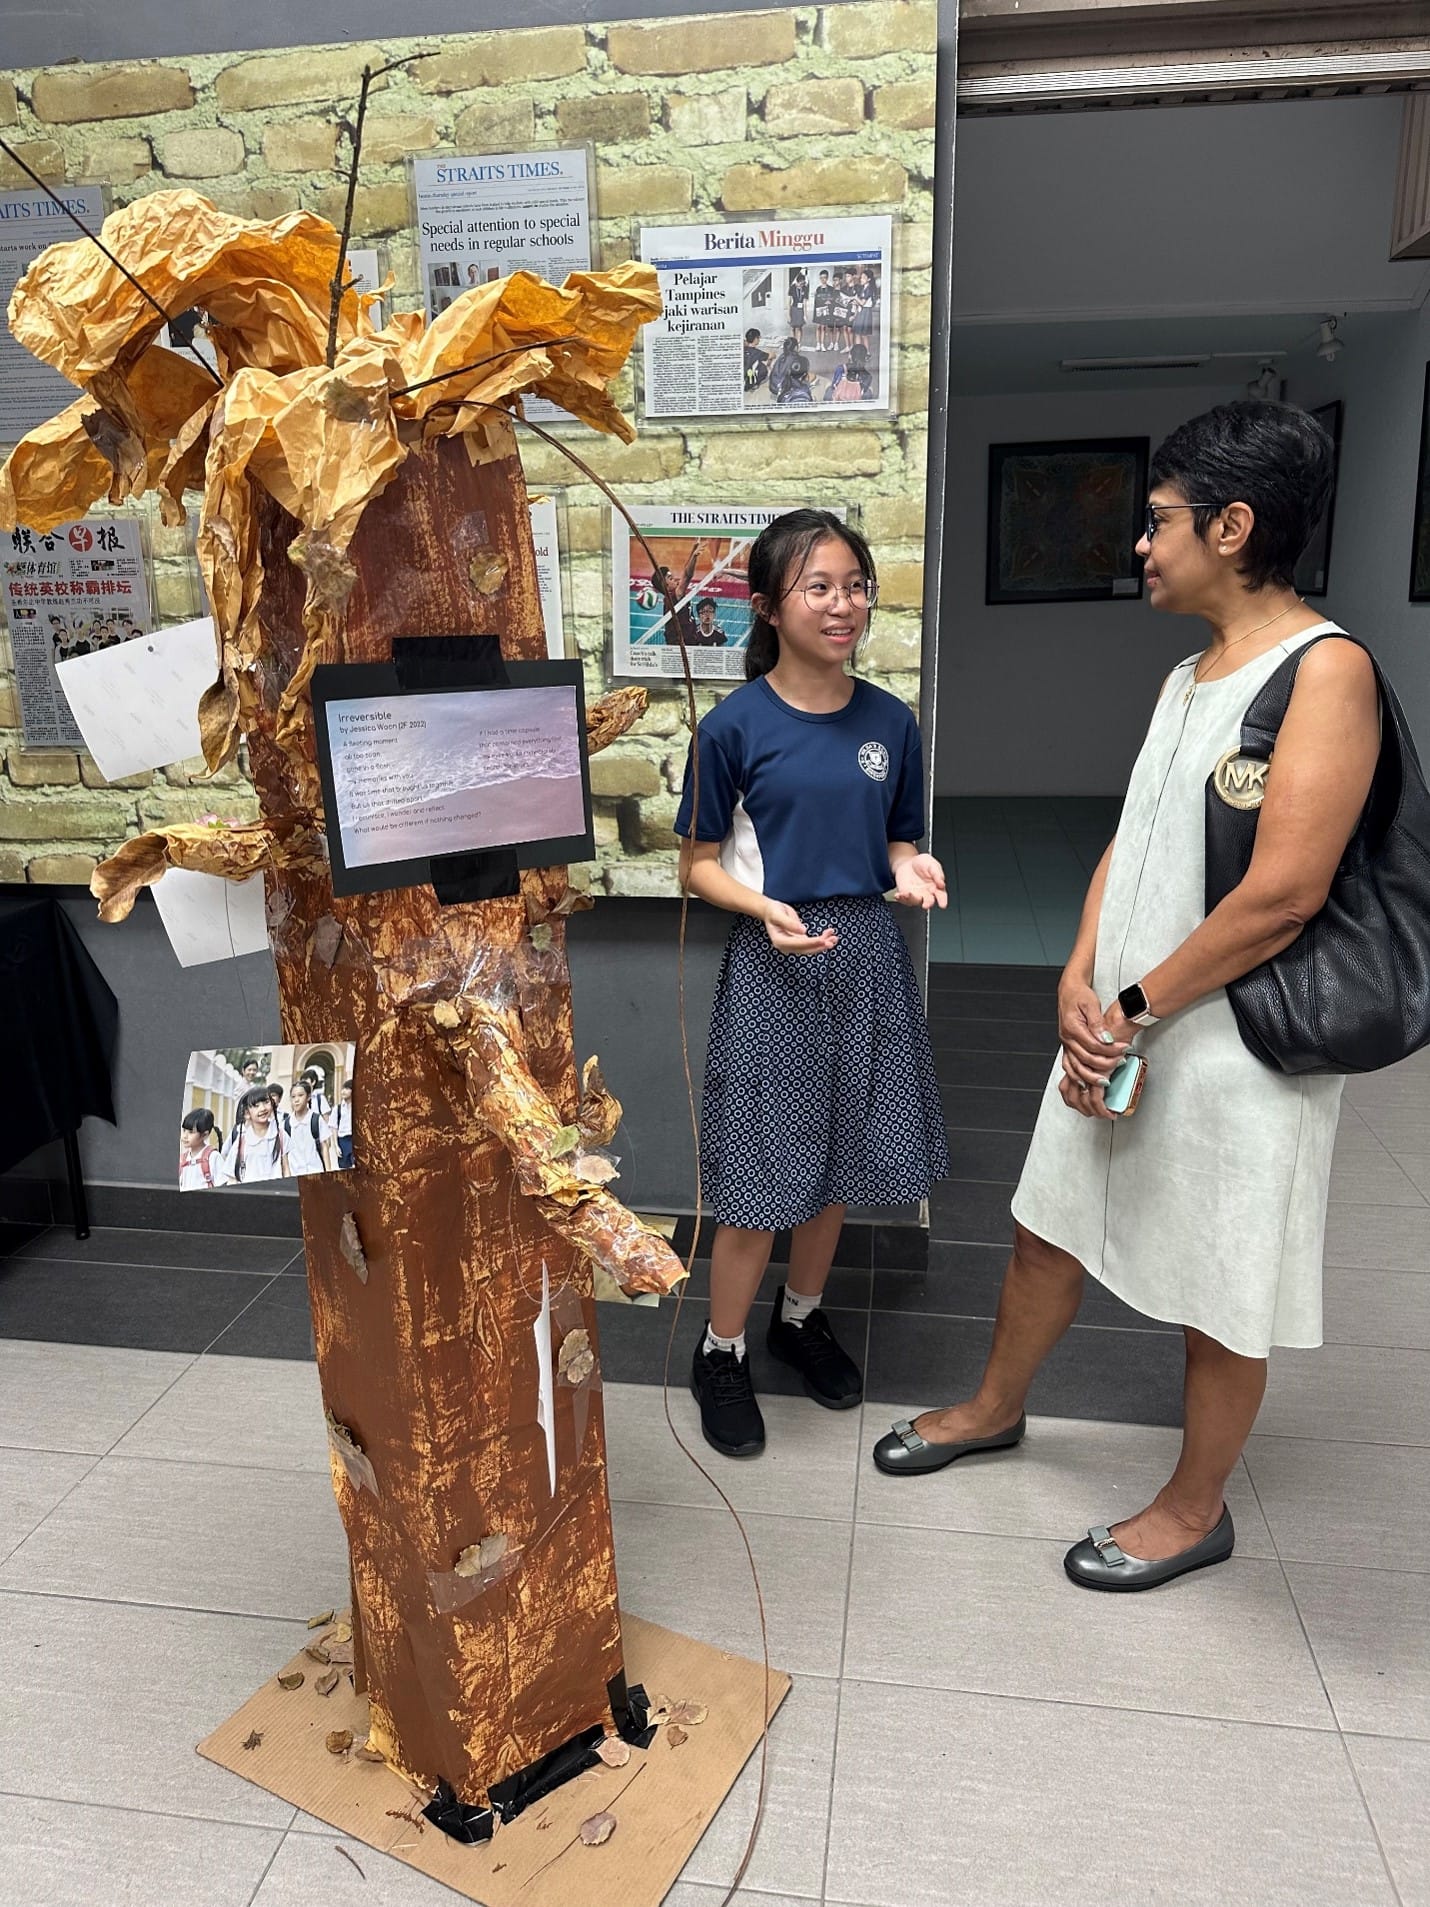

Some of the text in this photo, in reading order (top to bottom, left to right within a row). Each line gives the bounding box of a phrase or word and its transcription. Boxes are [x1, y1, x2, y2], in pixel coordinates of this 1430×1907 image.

[437, 165, 504, 183] STRAITS
[422, 213, 580, 238] Special attention to special
[0, 244, 17, 252] tarts
[19, 242, 36, 251] work
[430, 233, 574, 252] needs in regular schools
[704, 230, 825, 252] Berita Minggu
[674, 272, 718, 286] Pelajar
[665, 288, 726, 305] Tampines
[691, 304, 738, 316] warisan
[667, 318, 725, 335] kejiranan
[671, 512, 696, 524] THE
[698, 512, 748, 524] STRAITS
[8, 580, 132, 597] 传统英校称霸排坛
[338, 712, 392, 722] Irreversible
[340, 726, 348, 734] by
[350, 724, 376, 733] Jessica
[1223, 762, 1271, 791] MK
[371, 824, 388, 832] would
